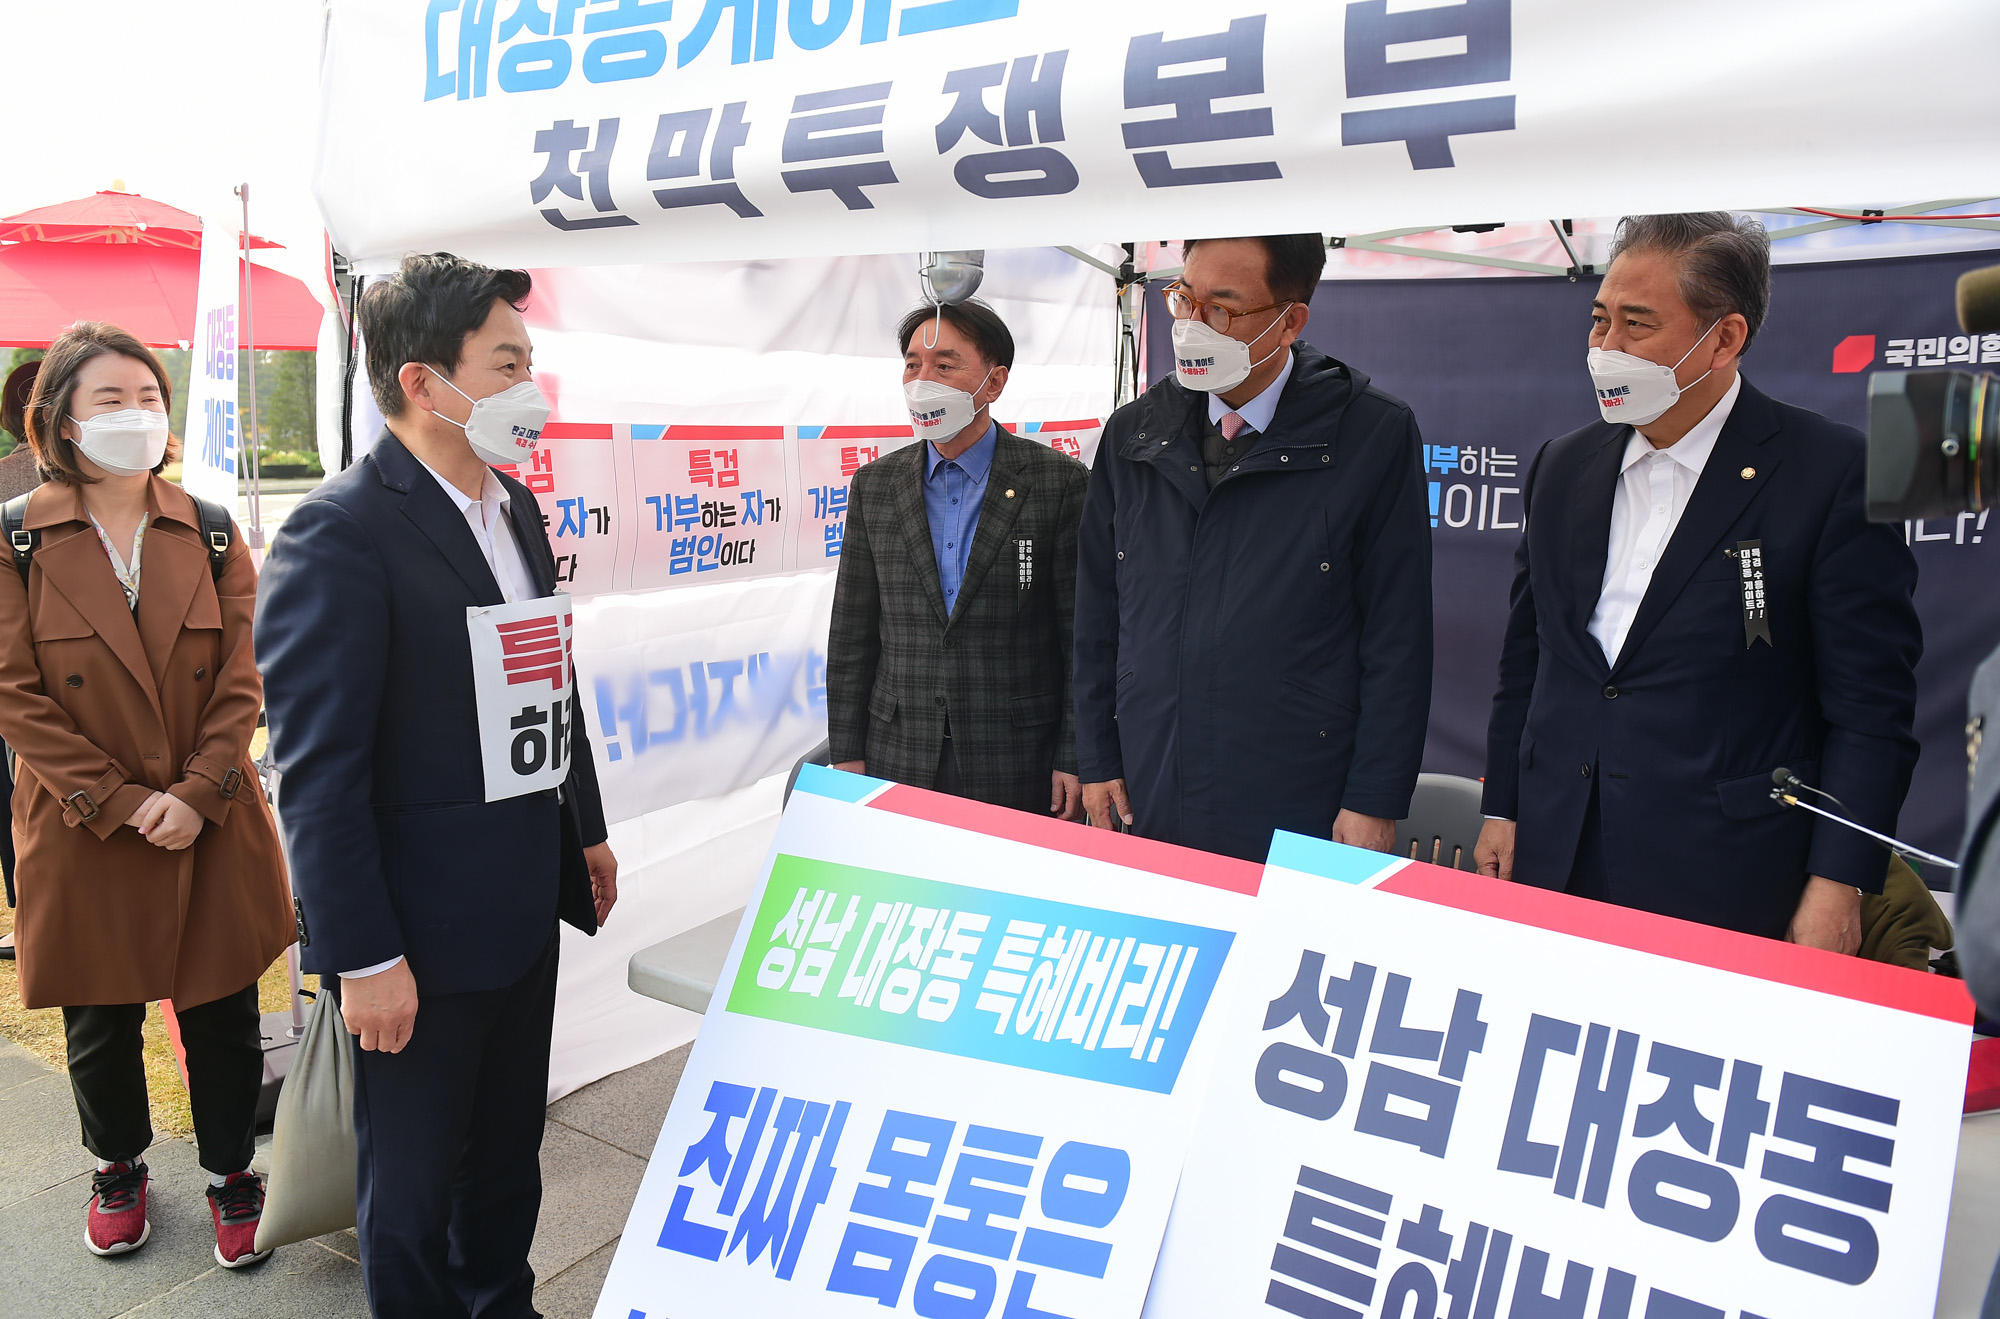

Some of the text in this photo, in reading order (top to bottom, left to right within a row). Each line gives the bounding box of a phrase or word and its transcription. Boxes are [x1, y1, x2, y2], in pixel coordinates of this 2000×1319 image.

[206, 304, 234, 380] 대장동
[1606, 385, 1631, 398] 게이트
[202, 398, 234, 474] 게이트
[689, 448, 740, 489] 특검
[556, 496, 611, 539] 자가
[645, 489, 782, 533] 거부하는 자가
[669, 532, 756, 576] 범인이다
[1740, 549, 1756, 620] 대장동 게이트!
[1751, 548, 1766, 619] 특검 수용하라!
[496, 613, 573, 690] 특
[510, 696, 572, 777] 하
[756, 887, 1200, 1065] 성남 대장동 특혜비리!
[1254, 949, 1901, 1286] 성남 대장동
[656, 1080, 1131, 1319] 진짜 몸통은
